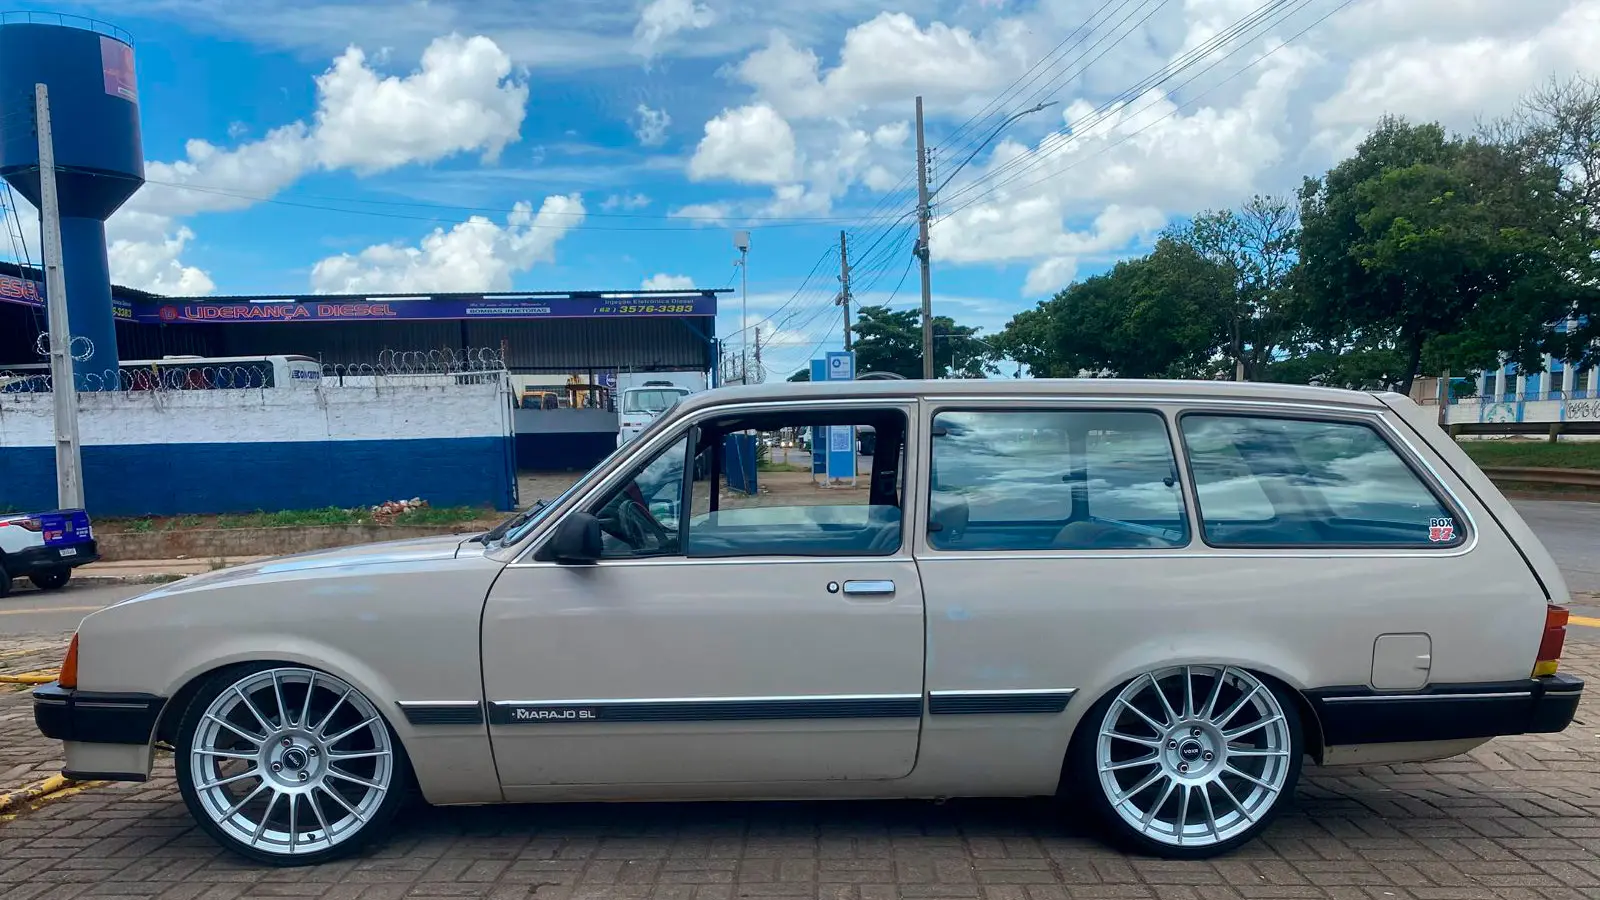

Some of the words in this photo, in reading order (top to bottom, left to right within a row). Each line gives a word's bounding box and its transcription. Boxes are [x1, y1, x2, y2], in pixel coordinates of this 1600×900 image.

[184, 305, 310, 320] LIDERANÇA
[317, 303, 397, 317] DIESEL
[619, 305, 694, 313] 3576-3383
[1431, 519, 1452, 527] BOX
[579, 710, 596, 719] SL
